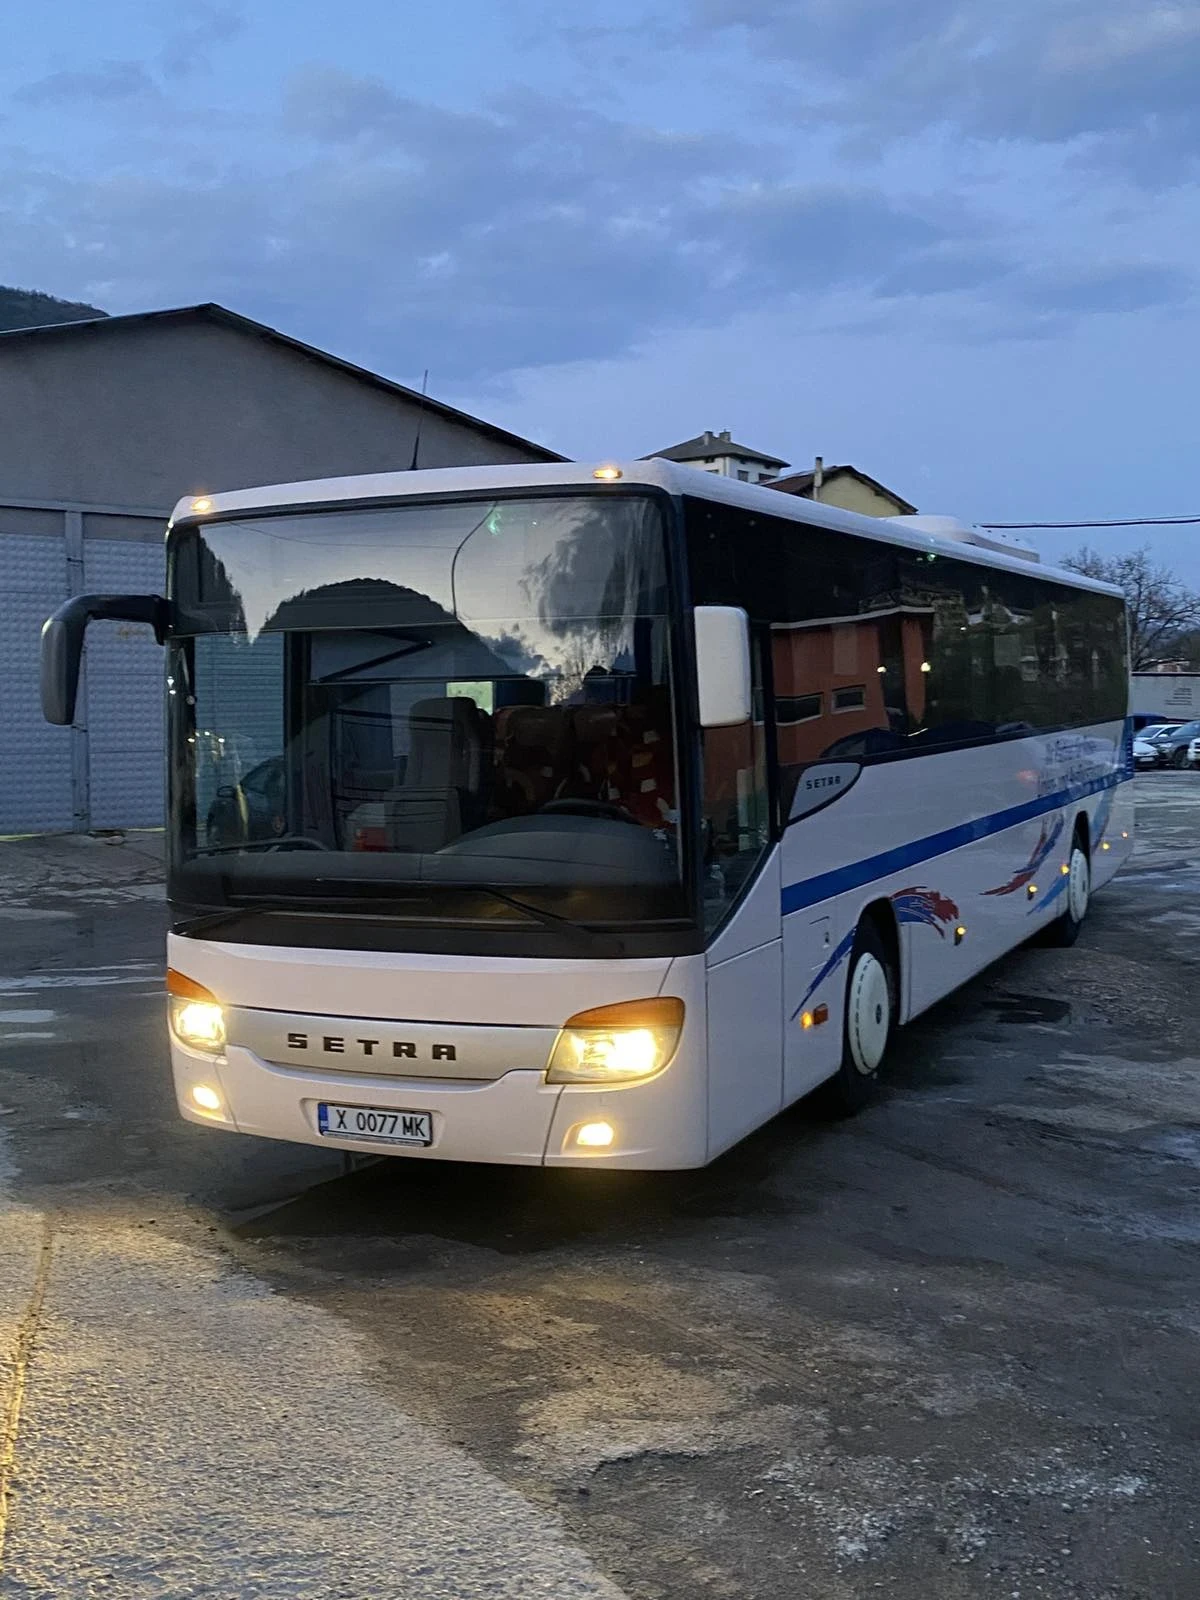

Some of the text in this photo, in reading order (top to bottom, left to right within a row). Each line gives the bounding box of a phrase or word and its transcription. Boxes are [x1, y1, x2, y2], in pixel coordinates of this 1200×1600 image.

[805, 775, 841, 790] SETRA
[287, 1033, 457, 1061] SETRA
[336, 1109, 426, 1138] X 0077 MK
